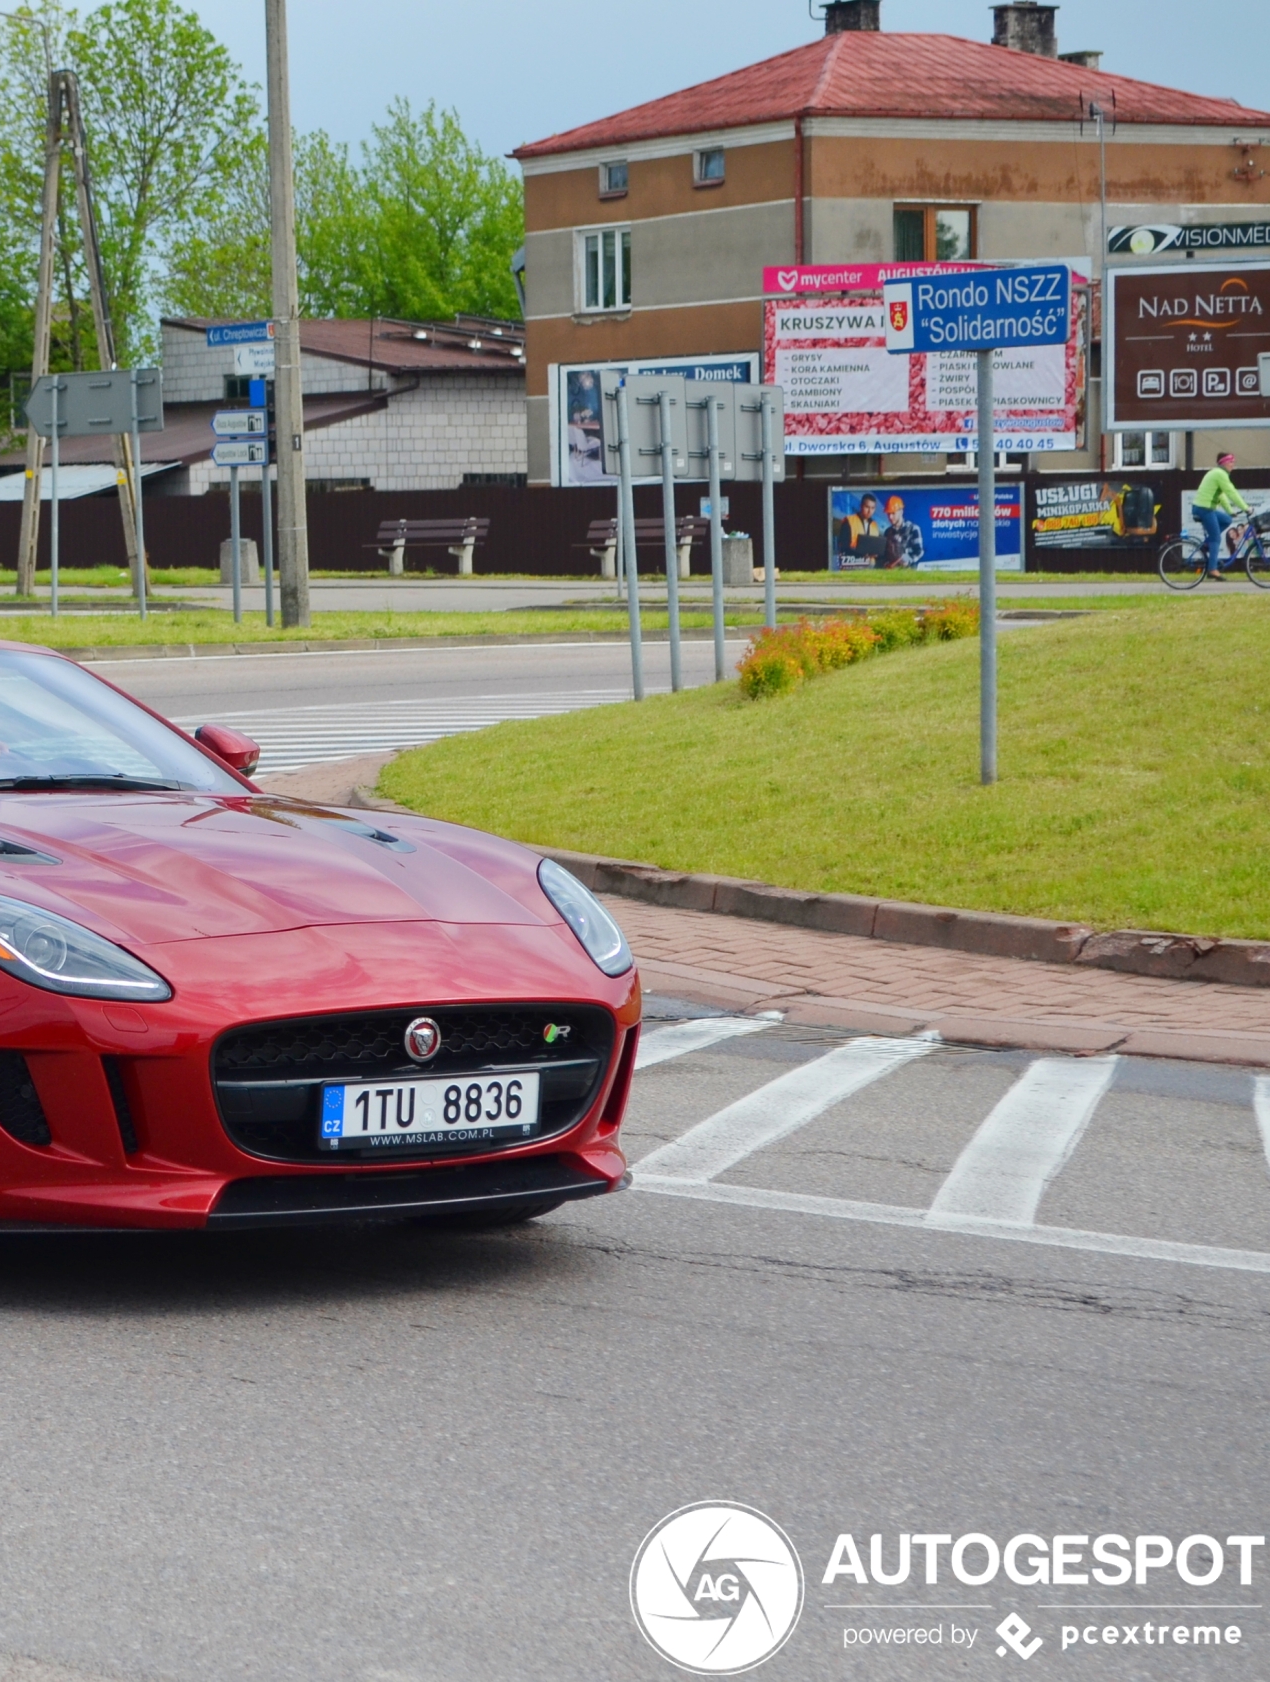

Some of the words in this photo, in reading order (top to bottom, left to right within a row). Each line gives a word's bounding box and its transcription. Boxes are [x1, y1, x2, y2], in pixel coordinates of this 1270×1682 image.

[801, 272, 862, 288] mycenter
[918, 281, 989, 311] Rondo
[996, 273, 1061, 304] NSZZ
[1138, 296, 1188, 318] NAD
[781, 316, 876, 331] KRUSZYWA
[1186, 343, 1214, 352] HOTEL
[791, 354, 822, 362] GRYSY
[939, 350, 1003, 359] CZARNM
[791, 365, 818, 374] KORA
[819, 364, 870, 373] KAMIENNA
[939, 362, 970, 371] PIASKI
[973, 361, 1035, 371] BOWLANE
[695, 364, 742, 382] Domek
[939, 373, 970, 383] ŻWIRY
[790, 376, 840, 386] OTOCZAKI
[790, 388, 842, 397] GAMBIONY
[939, 385, 976, 395] POSPÓŁ
[790, 400, 840, 409] SKALNIAKI
[939, 398, 972, 407] PIASEK
[295, 436, 300, 449] 1
[798, 441, 855, 452] Dworska
[858, 440, 870, 453] 6,
[874, 438, 941, 453] Augustów
[996, 438, 1013, 449] 40
[1017, 438, 1033, 449] 40
[1037, 438, 1054, 449] 45
[1035, 483, 1098, 505] USŁUGI
[932, 506, 951, 518] 770
[953, 505, 1011, 517] miliów
[1037, 501, 1110, 518] MINIKOPARKA
[932, 518, 965, 530] złotych
[932, 529, 978, 540] inwestycje
[557, 1025, 571, 1038] R
[355, 1087, 416, 1131] 1TU
[443, 1079, 523, 1125] 8836
[324, 1120, 340, 1133] CZ
[370, 1128, 494, 1146] WWW.MSLAB.COM.PL
